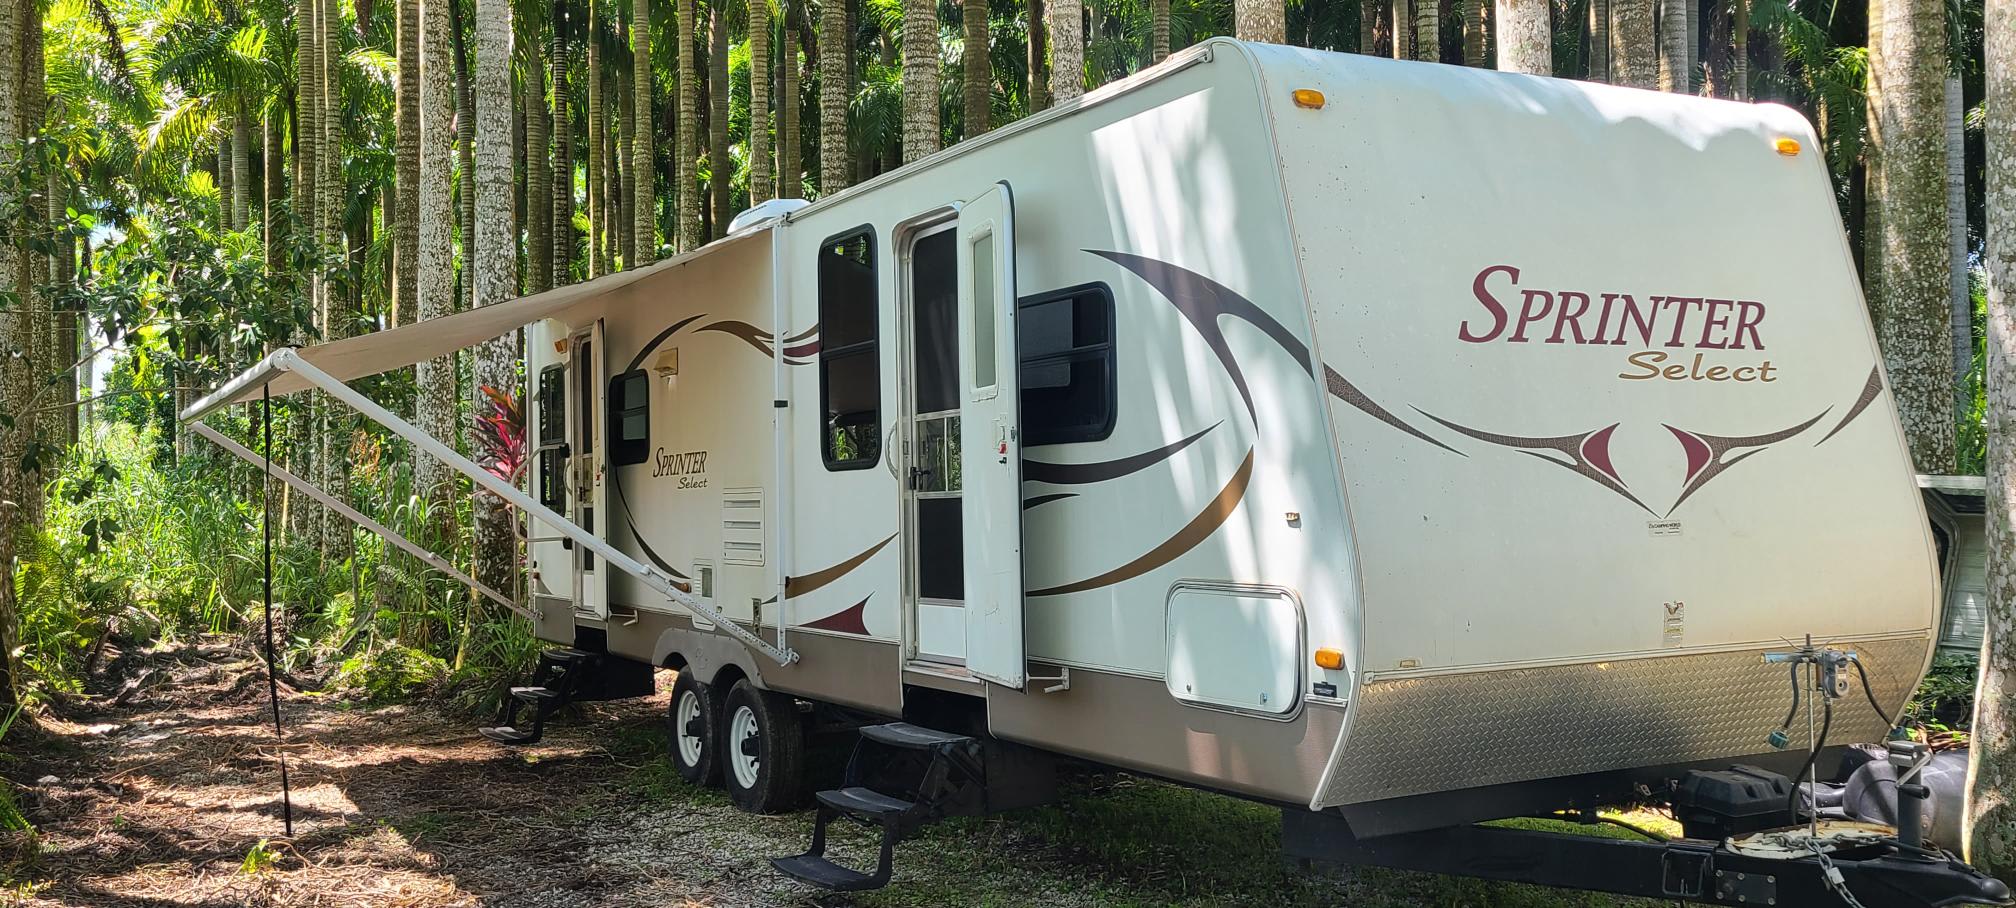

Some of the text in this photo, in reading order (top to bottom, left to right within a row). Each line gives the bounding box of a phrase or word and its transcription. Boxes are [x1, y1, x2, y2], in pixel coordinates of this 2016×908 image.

[1458, 265, 1766, 350] SPRINTER
[1619, 351, 1777, 382] Select
[653, 446, 707, 478] SPRINTER
[677, 476, 708, 489] Select
